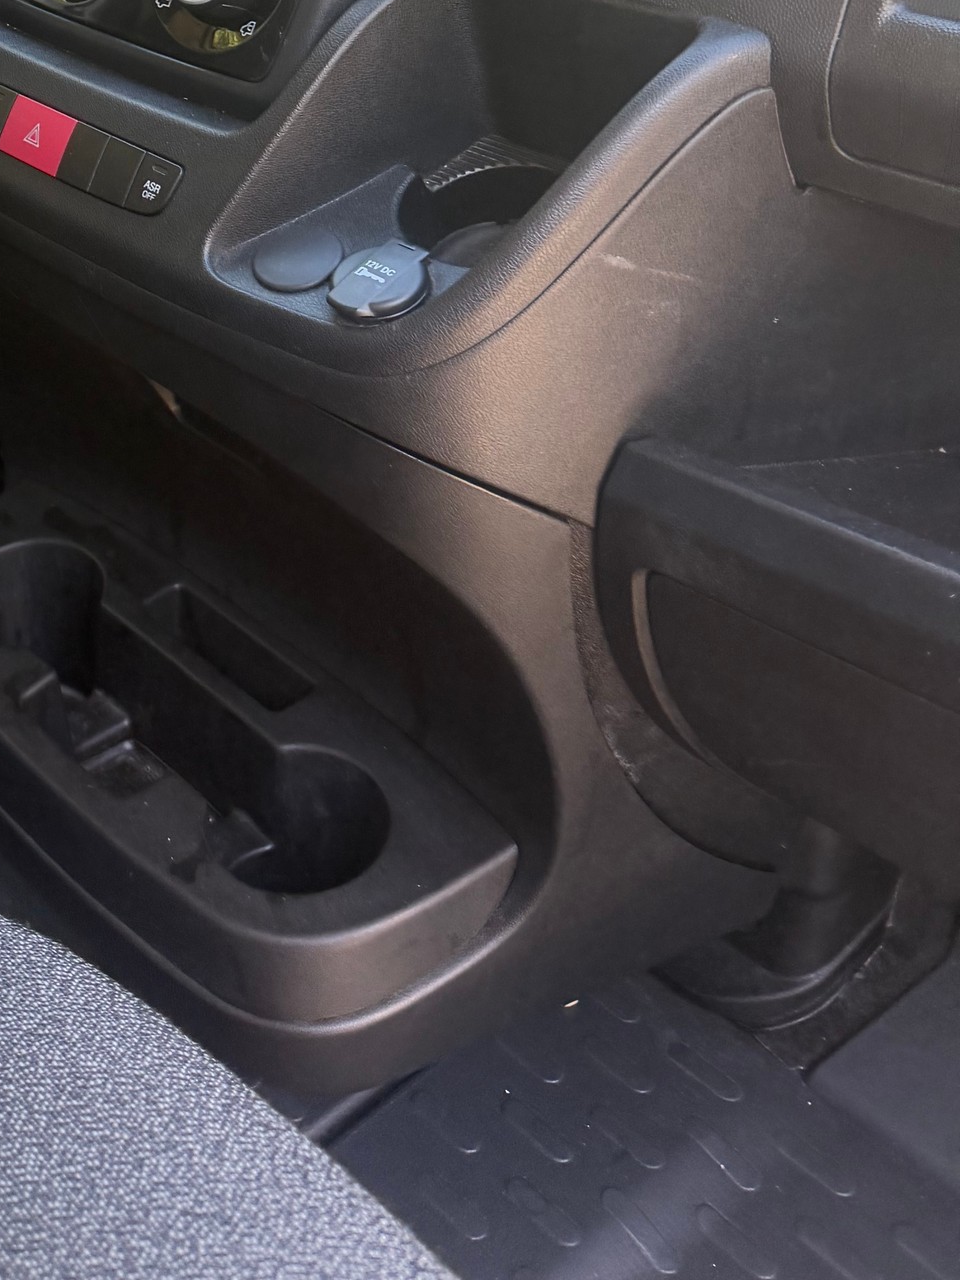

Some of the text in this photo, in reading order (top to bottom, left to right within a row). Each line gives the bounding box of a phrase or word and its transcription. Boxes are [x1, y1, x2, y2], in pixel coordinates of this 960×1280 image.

[143, 179, 161, 194] ASR
[141, 190, 156, 201] OFF
[365, 260, 396, 277] 12V DC
